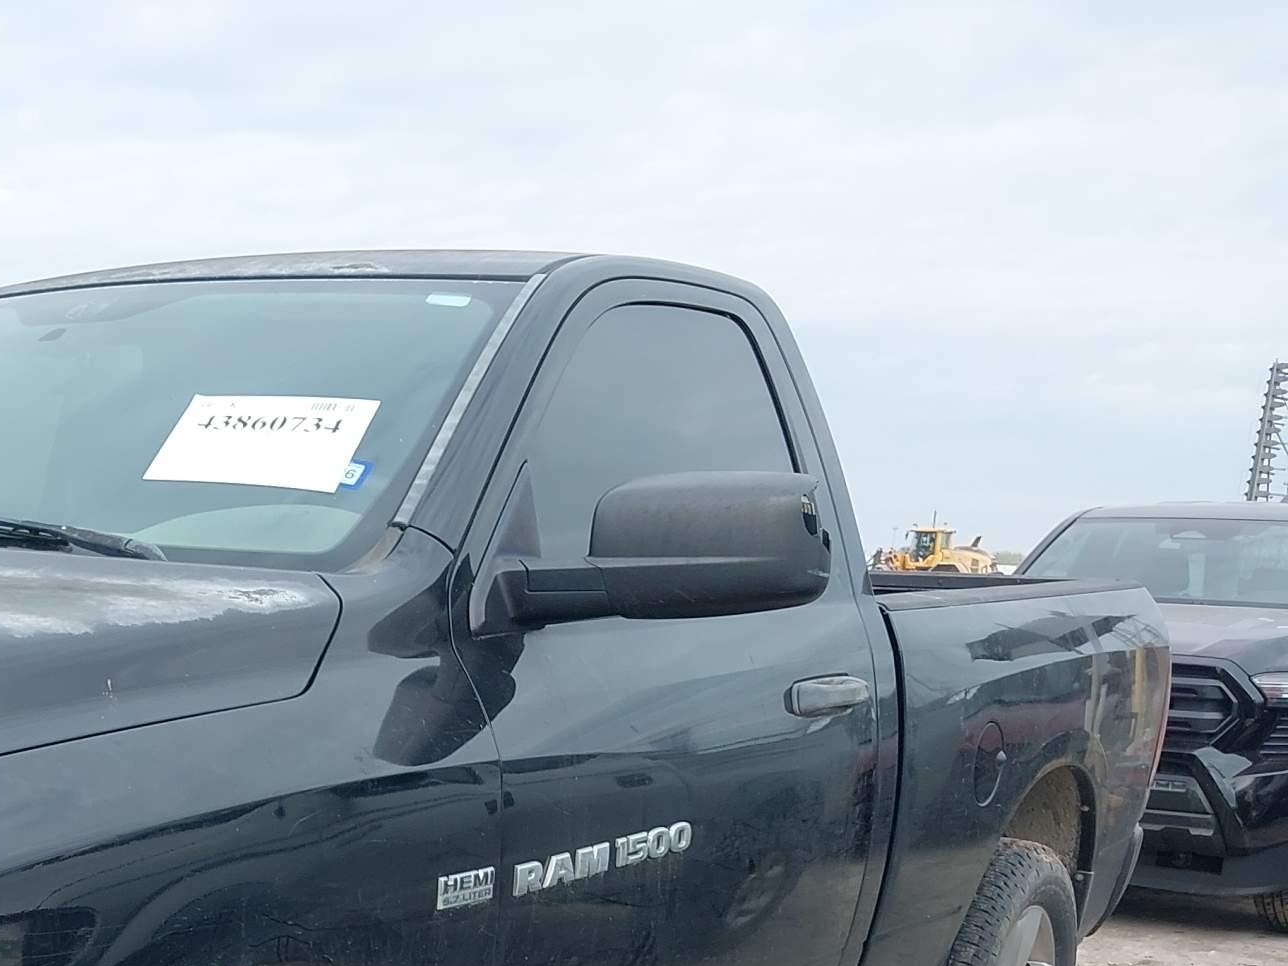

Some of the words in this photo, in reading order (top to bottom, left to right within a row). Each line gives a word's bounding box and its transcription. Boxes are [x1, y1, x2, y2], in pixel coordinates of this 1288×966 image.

[197, 415, 343, 434] 43860734
[513, 842, 610, 896] RAM
[615, 821, 692, 867] 1500
[437, 866, 495, 897] HEMI
